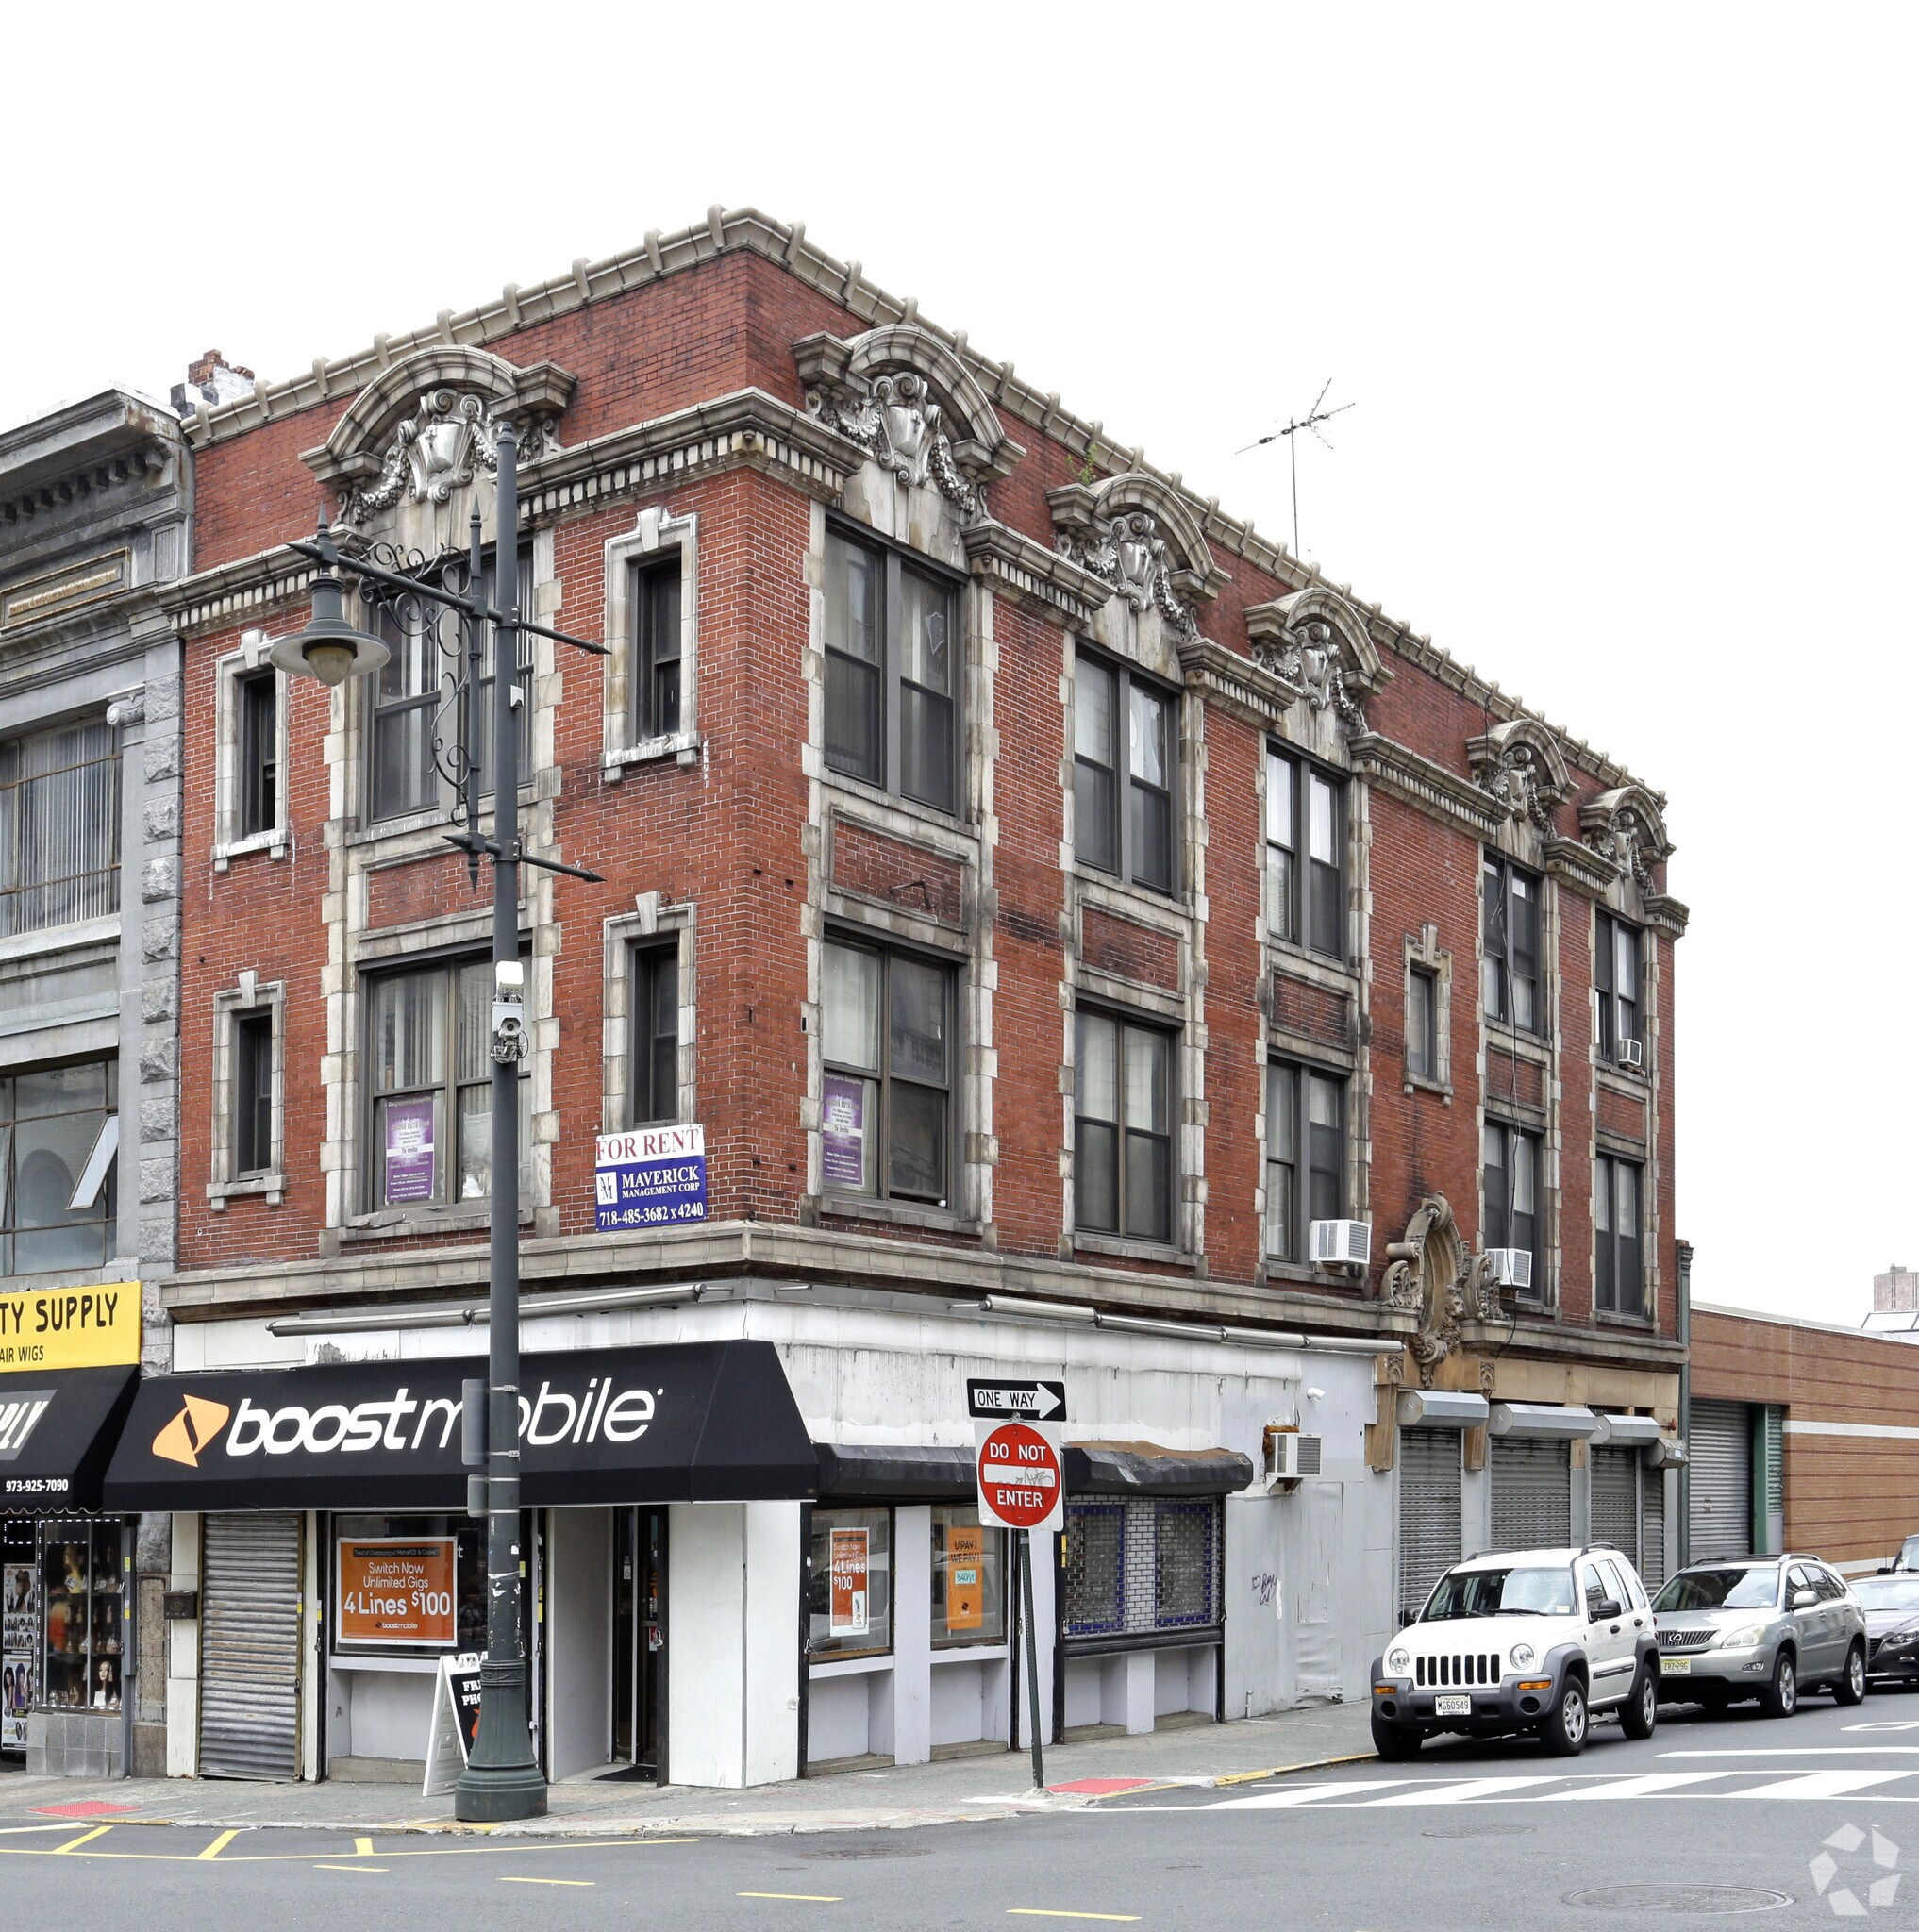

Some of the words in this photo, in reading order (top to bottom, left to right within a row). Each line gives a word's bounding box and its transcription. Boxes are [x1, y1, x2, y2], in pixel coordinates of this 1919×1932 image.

[596, 1137, 637, 1161] FOR
[643, 1129, 699, 1156] RENT
[622, 1165, 700, 1189] MAVERICK
[622, 1184, 677, 1199] MANAGEMENT
[678, 1182, 700, 1192] CORP
[599, 1206, 668, 1226] 718-485-3682
[670, 1208, 677, 1219] x
[678, 1202, 704, 1218] 4240
[0, 1301, 25, 1335] TY
[36, 1292, 118, 1332] SUPPLY
[18, 1345, 44, 1362] WIGS
[977, 1391, 1002, 1407] ONE
[1010, 1391, 1036, 1408] WAY
[225, 1377, 656, 1457] boostmbile
[989, 1442, 1010, 1458] DO
[1018, 1444, 1046, 1461] NOT
[6, 1478, 69, 1492] 973-925-7090
[996, 1489, 1043, 1508] ENTER
[369, 1561, 400, 1574] Switch
[402, 1561, 424, 1574] Now
[842, 1560, 866, 1574] Lines
[363, 1576, 406, 1588] Unlimited
[408, 1575, 429, 1591] Gigs
[833, 1575, 853, 1591] $100
[359, 1591, 407, 1616] Lines
[411, 1591, 451, 1616] $100
